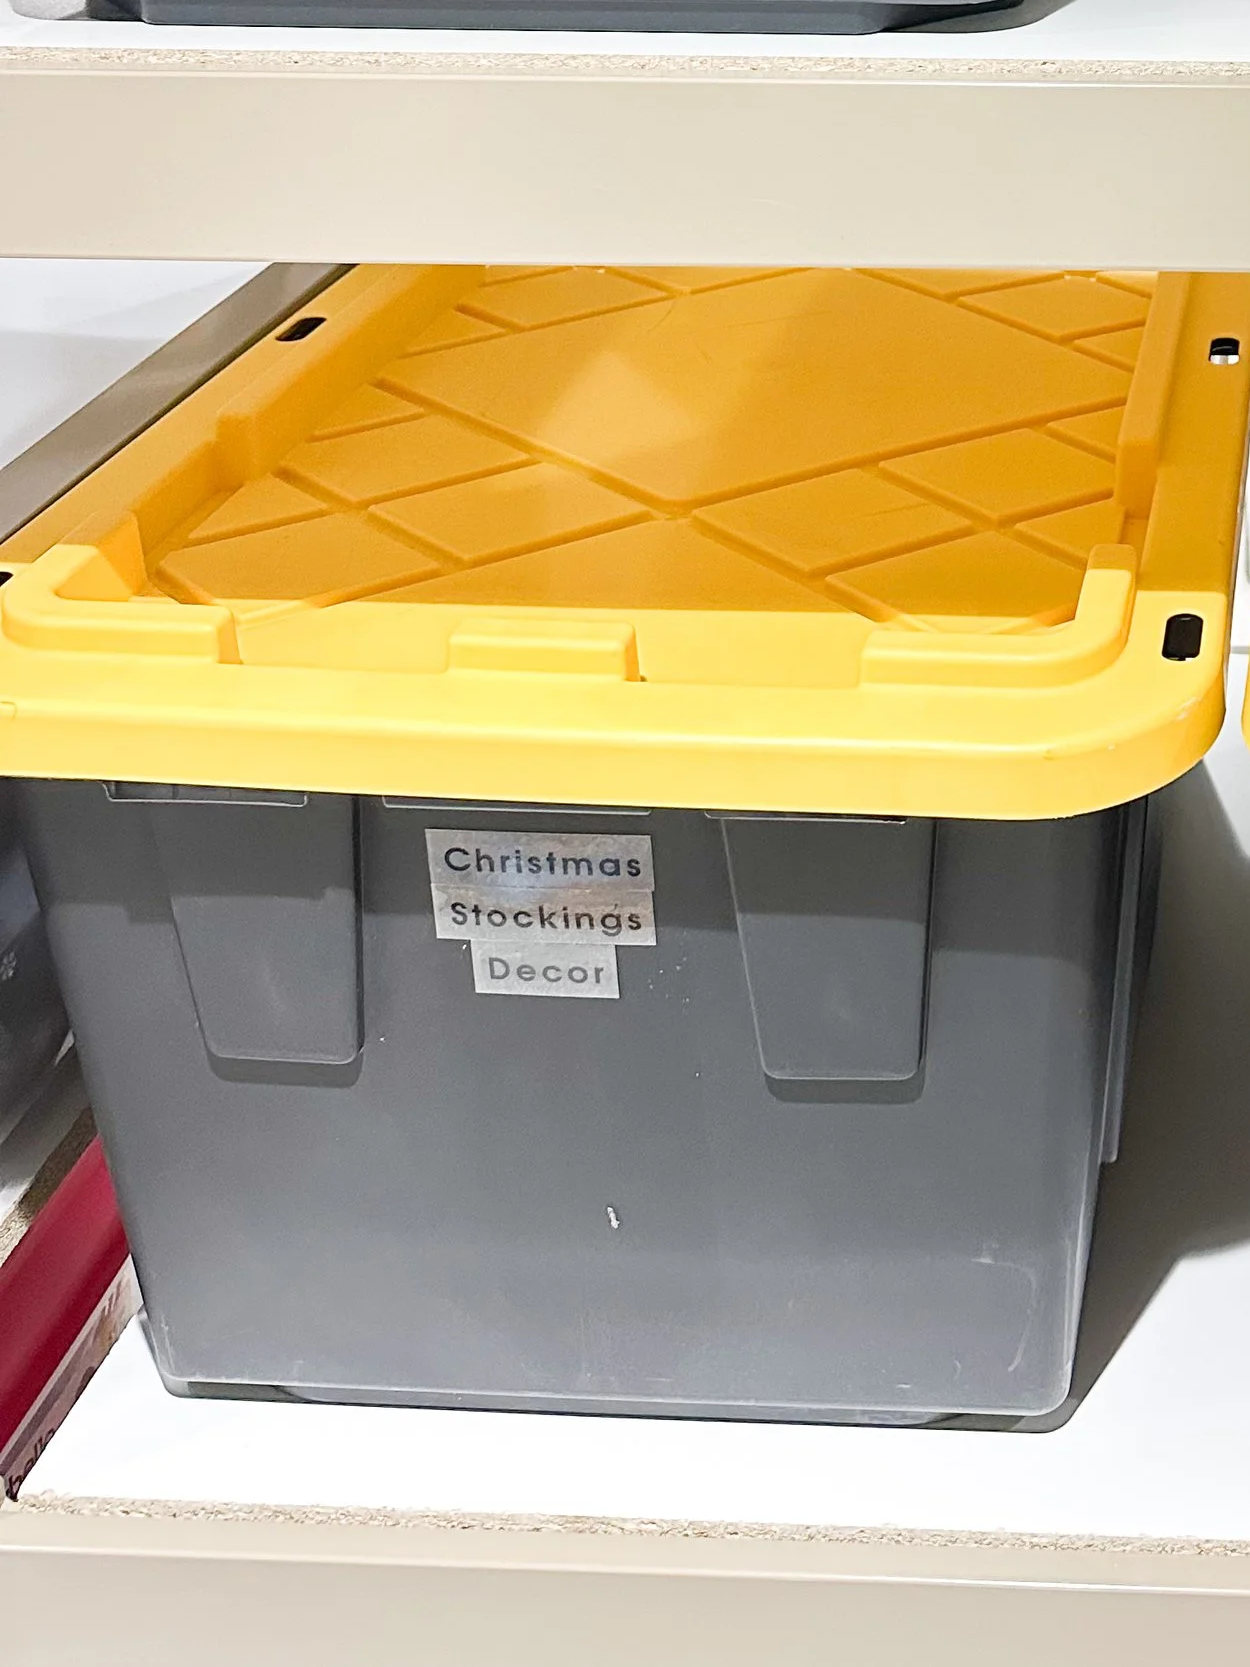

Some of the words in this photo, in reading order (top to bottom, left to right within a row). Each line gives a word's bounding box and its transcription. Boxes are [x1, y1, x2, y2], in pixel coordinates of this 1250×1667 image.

[444, 847, 642, 877] Christmas
[450, 901, 643, 937] Stockings
[488, 956, 605, 984] Decor
